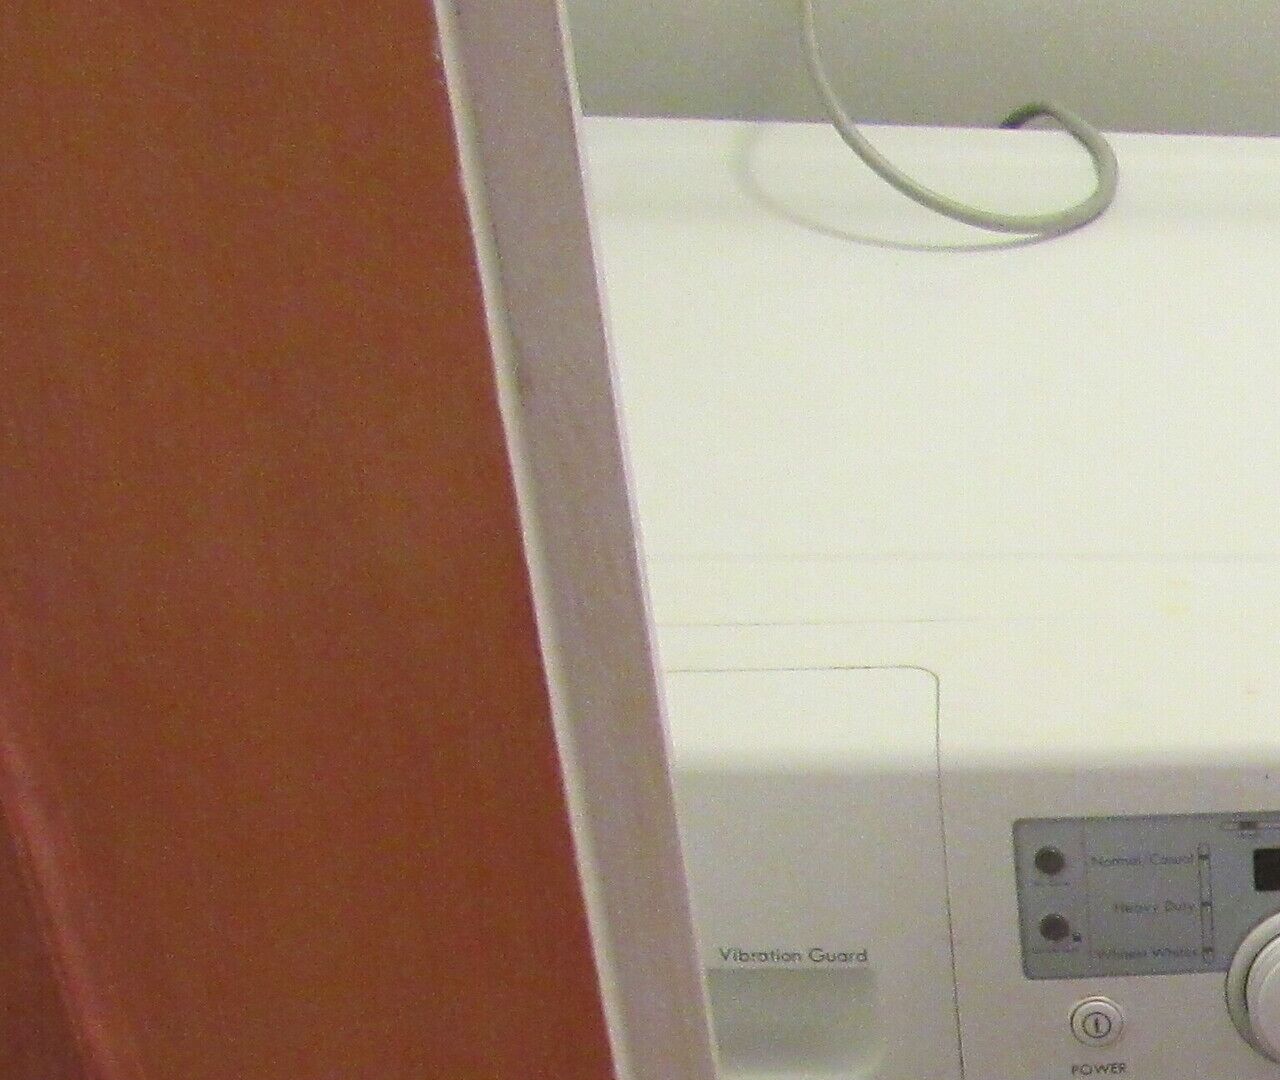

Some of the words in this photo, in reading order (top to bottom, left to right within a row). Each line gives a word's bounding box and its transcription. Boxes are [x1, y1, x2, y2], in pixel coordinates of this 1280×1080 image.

[719, 947, 802, 963] Vibration
[808, 947, 869, 963] Guard
[1071, 1063, 1126, 1076] POWER
